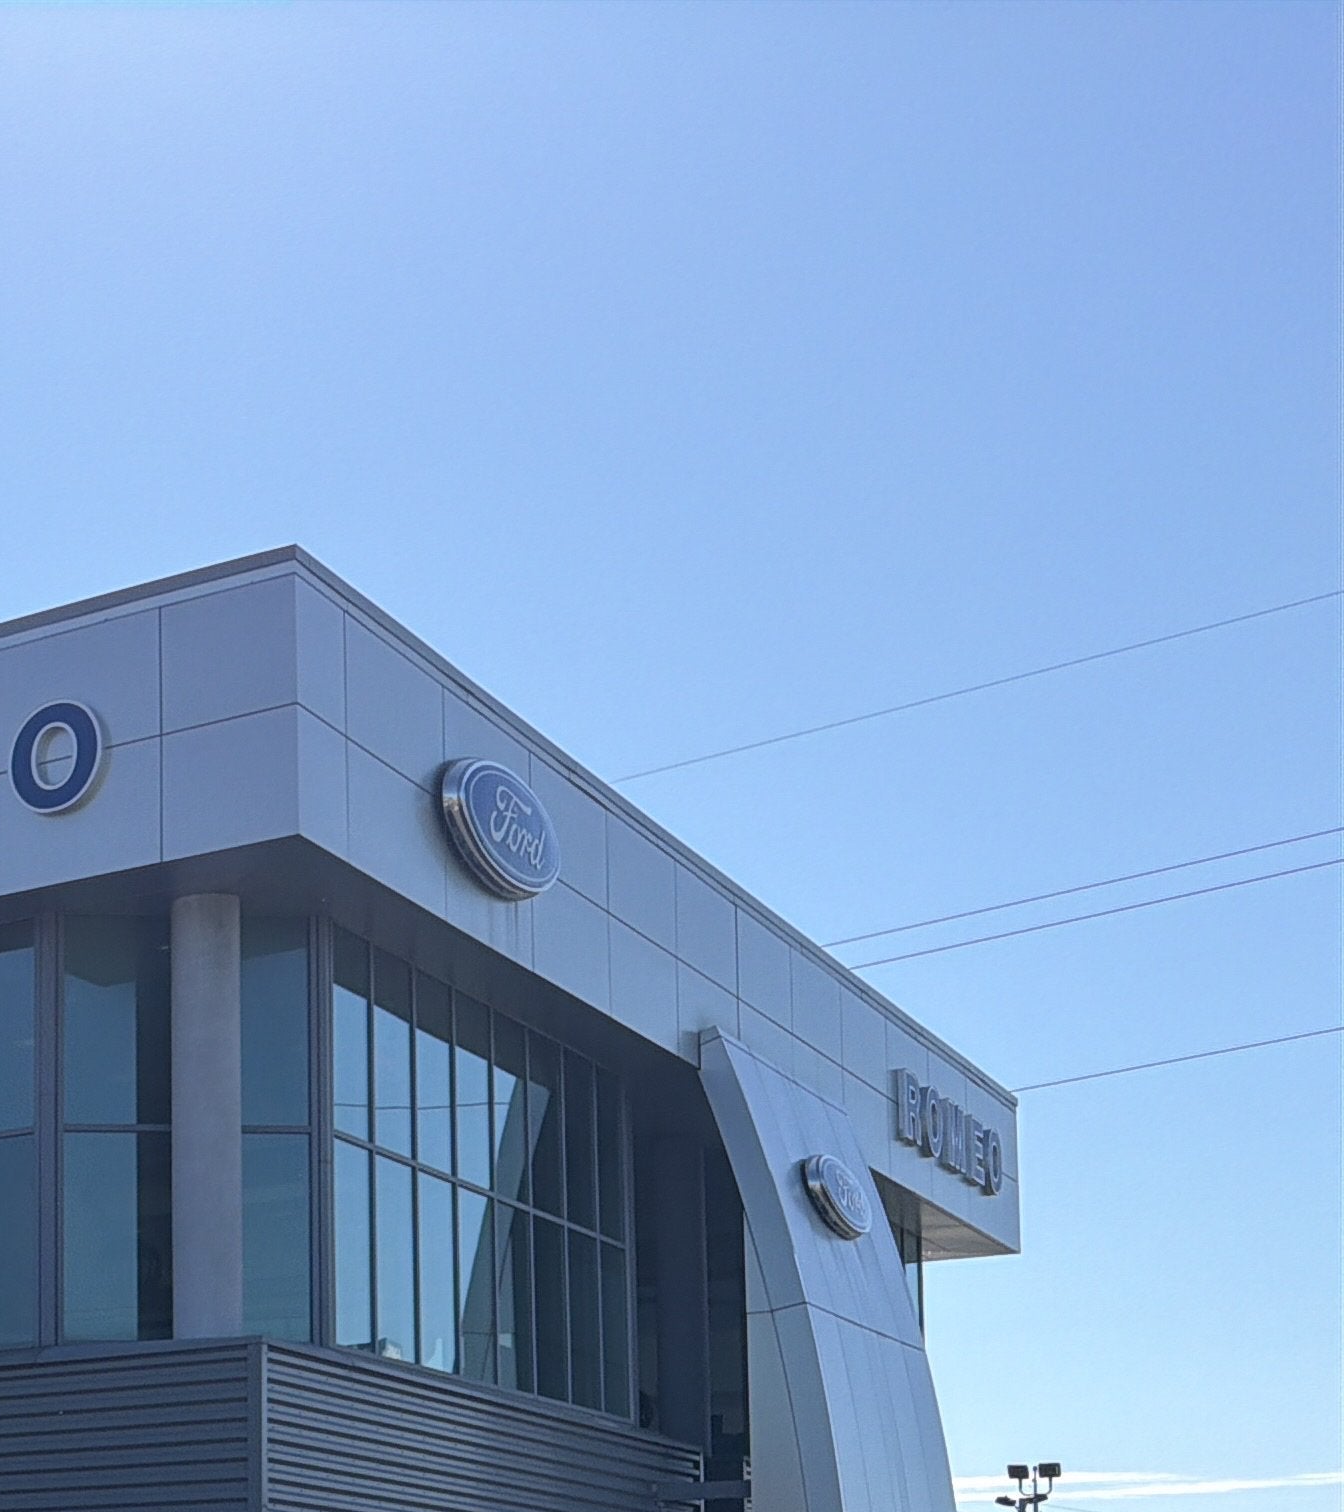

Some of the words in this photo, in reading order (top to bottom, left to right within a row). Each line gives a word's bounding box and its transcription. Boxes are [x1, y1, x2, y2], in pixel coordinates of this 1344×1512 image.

[490, 785, 546, 870] Ford
[896, 1067, 1003, 1196] ROMEO
[836, 1168, 866, 1217] Ford
